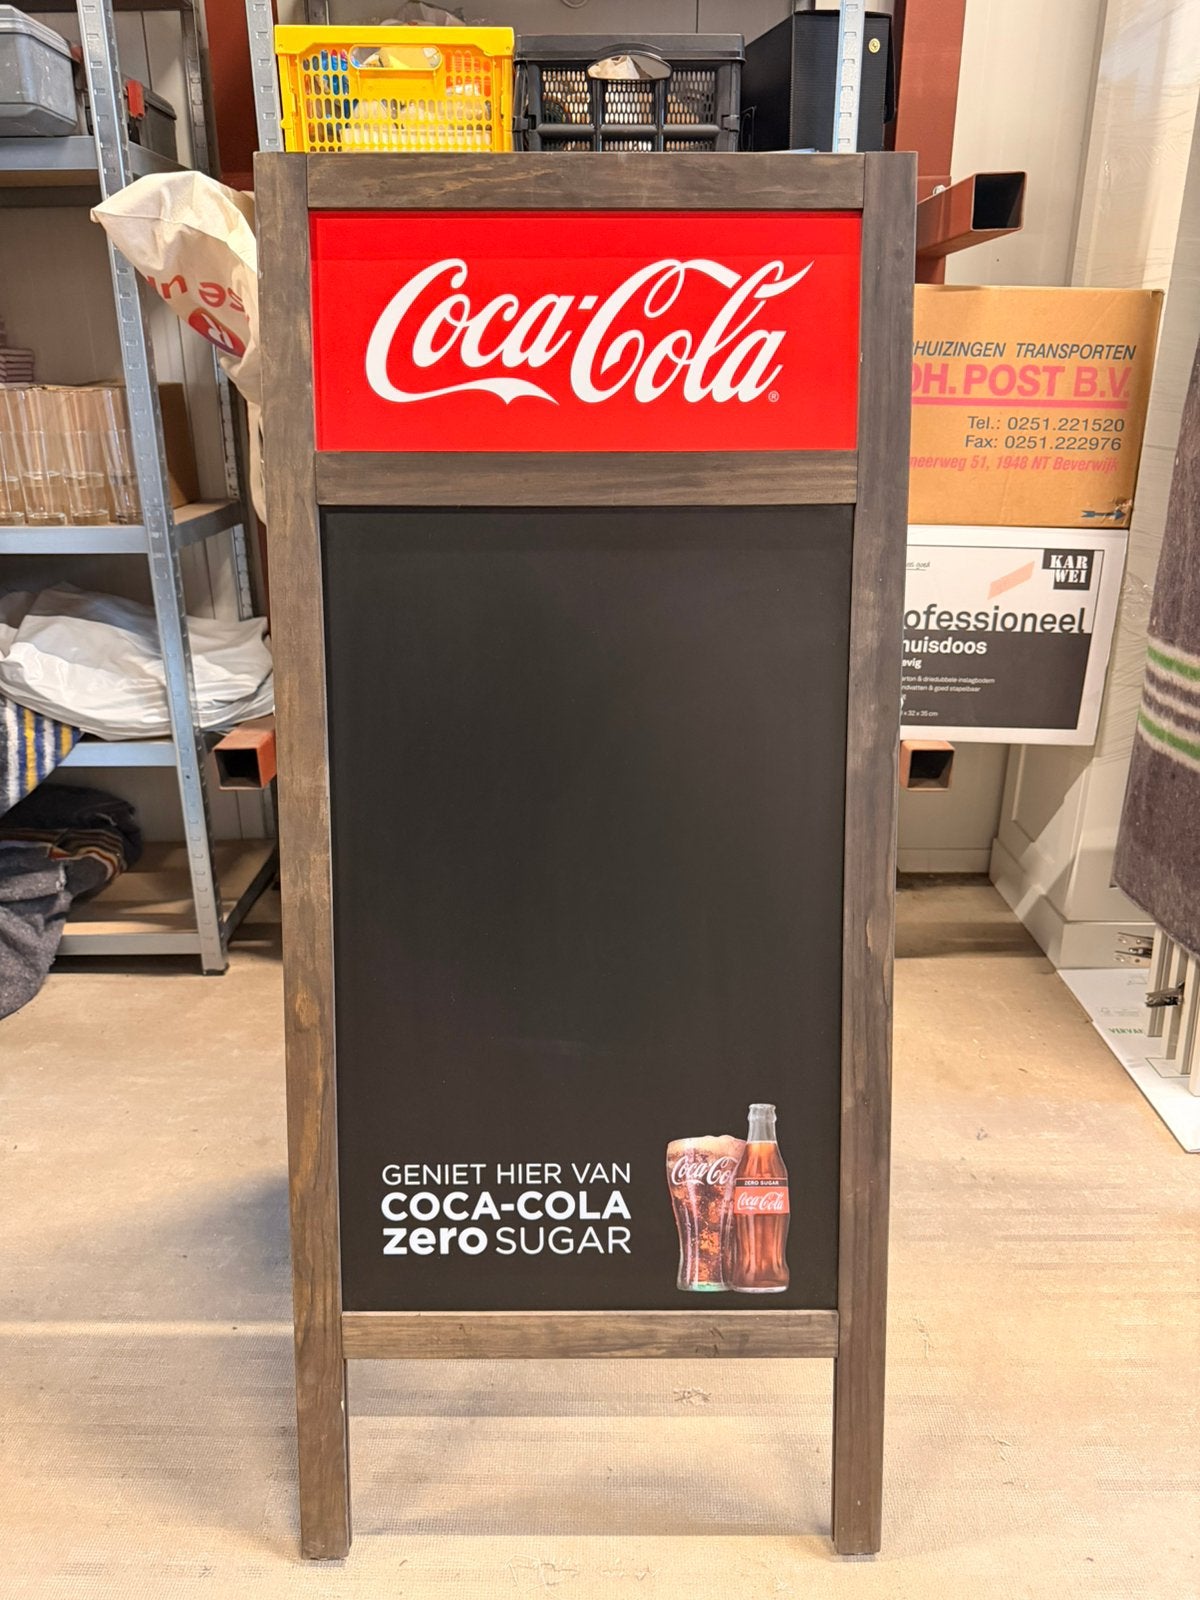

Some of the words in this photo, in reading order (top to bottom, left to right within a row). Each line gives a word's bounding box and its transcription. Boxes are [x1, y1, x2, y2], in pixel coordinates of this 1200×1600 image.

[365, 258, 816, 405] Coca-Cola
[913, 341, 1006, 358] HUIZINGEN
[1015, 342, 1137, 361] TRANSPORTEN
[963, 363, 1066, 397] POST
[1073, 366, 1132, 399] B.V.
[1007, 416, 1125, 432] 0251.221520
[965, 434, 998, 449] Fax:
[1004, 434, 1122, 451] 0251.222976
[1031, 456, 1051, 470] NT
[1052, 456, 1118, 474] Beverwijk
[1050, 554, 1088, 569] KAR
[1054, 568, 1086, 583] WEI
[904, 603, 1086, 634] ofessioneel
[382, 1164, 487, 1186] GENIET
[497, 1163, 562, 1184] HIER
[571, 1162, 631, 1184] VAN
[381, 1190, 632, 1221] COCA-COLA
[737, 1191, 784, 1211] Coca-Cola
[383, 1227, 488, 1255] zero
[496, 1226, 632, 1255] SUGAR
